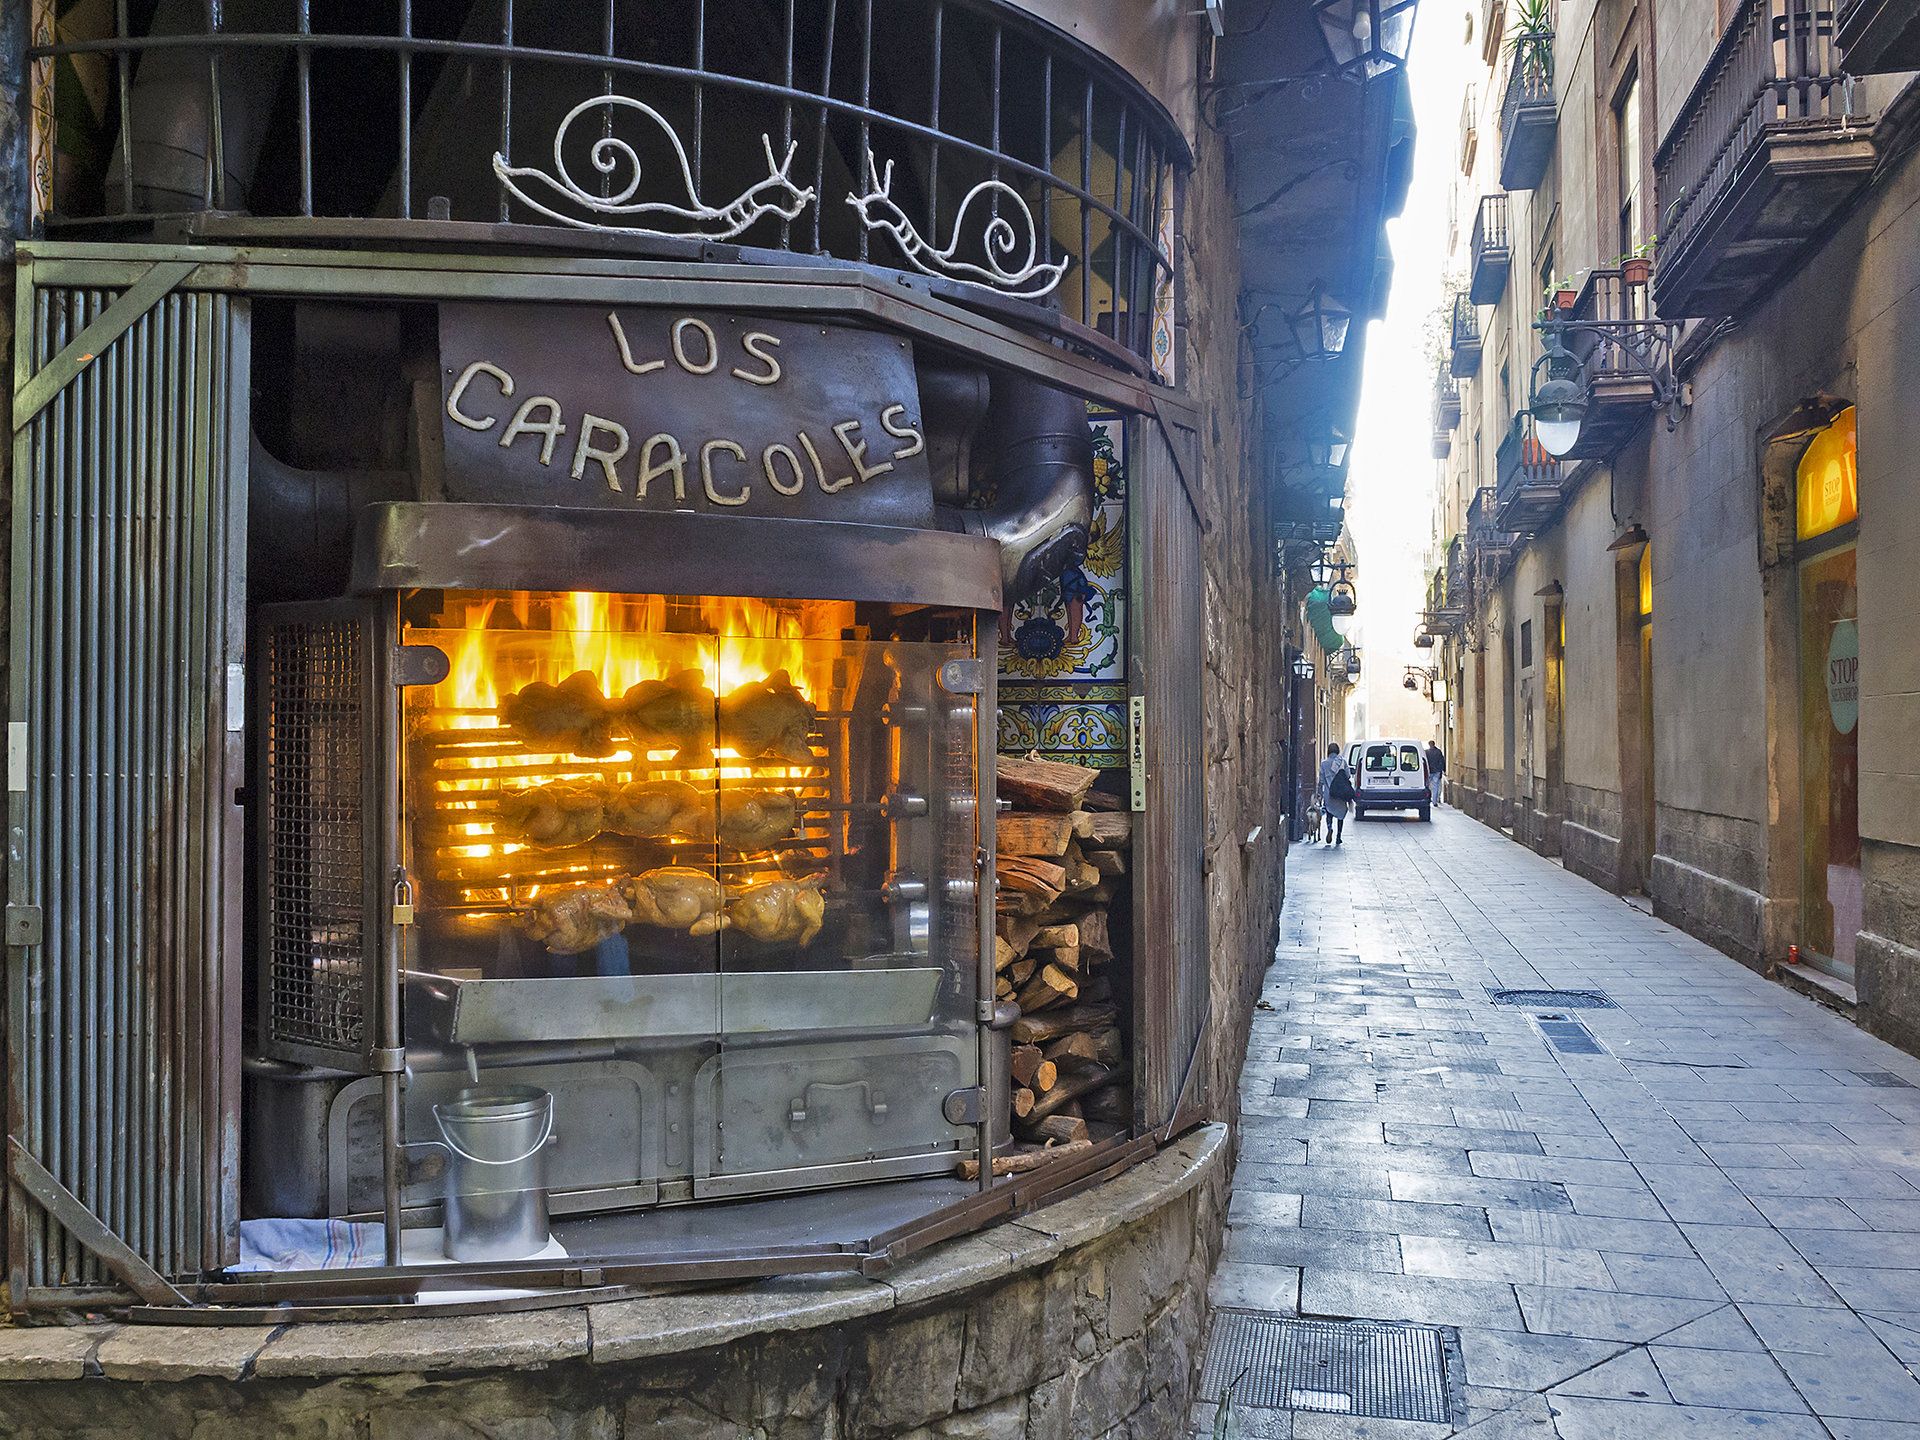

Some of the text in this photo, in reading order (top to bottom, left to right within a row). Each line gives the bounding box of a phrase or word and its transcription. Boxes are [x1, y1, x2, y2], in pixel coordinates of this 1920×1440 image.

[607, 310, 782, 386] LOS
[445, 360, 925, 507] CARACOLES
[1824, 476, 1841, 498] STOP
[1830, 656, 1859, 685] STOP
